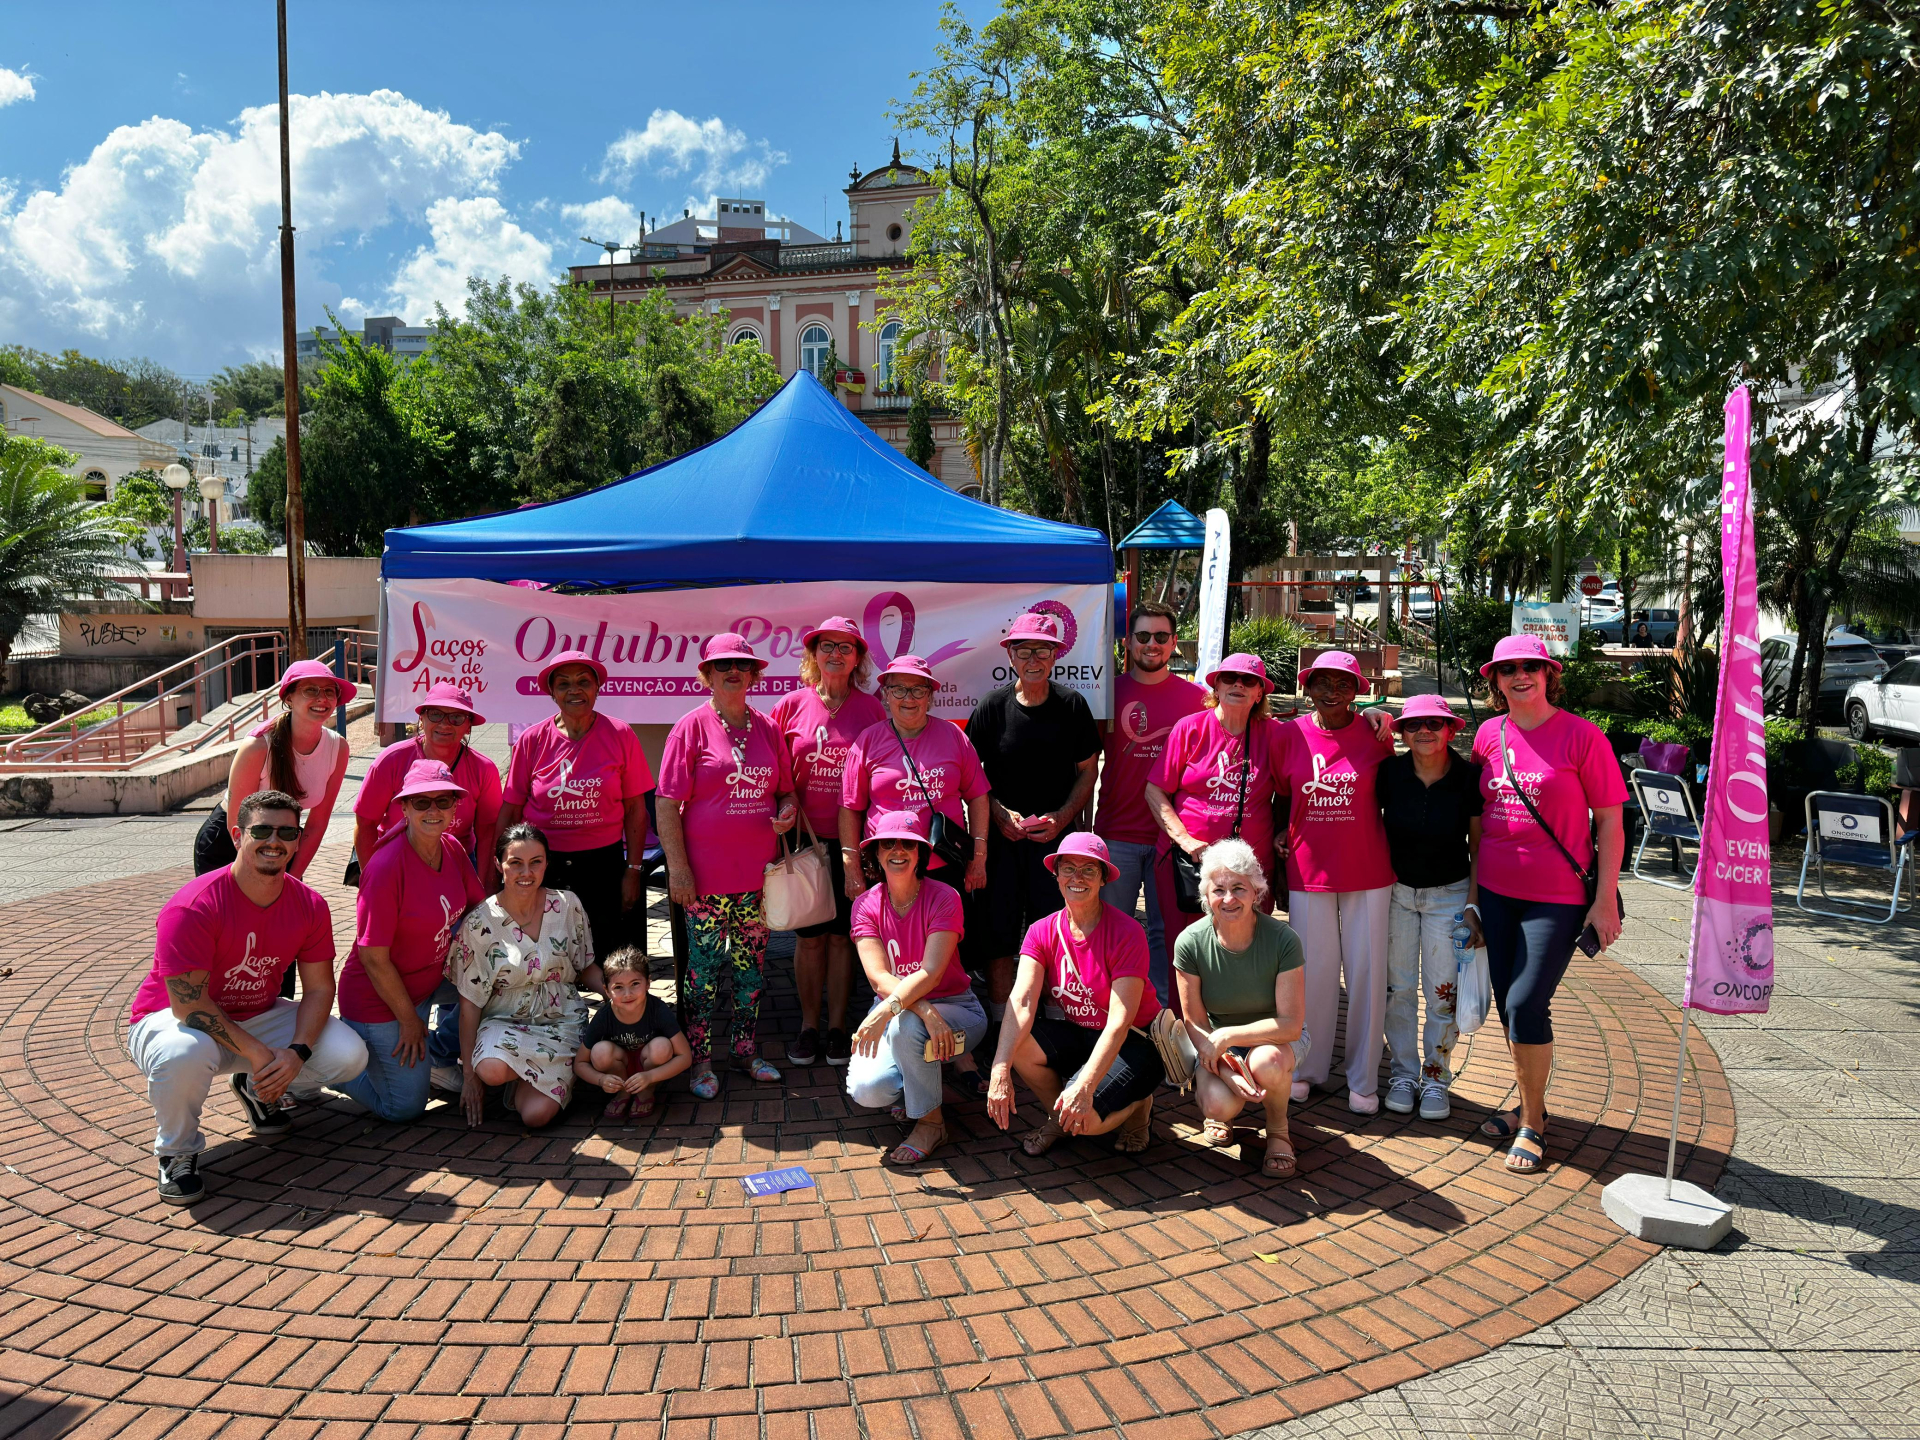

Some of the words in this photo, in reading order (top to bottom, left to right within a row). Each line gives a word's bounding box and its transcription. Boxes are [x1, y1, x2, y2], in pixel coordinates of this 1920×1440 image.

[392, 601, 488, 673] Laços
[462, 657, 483, 674] de
[992, 665, 1104, 681] ONPREV
[599, 679, 676, 695] REVENÇÃO
[682, 681, 703, 692] AO
[773, 680, 791, 692] DE
[934, 696, 979, 707] uidado
[547, 759, 603, 799] Laços
[1301, 753, 1359, 795] Laços
[758, 777, 769, 788] de
[931, 778, 945, 789] de
[1339, 783, 1355, 795] de
[1525, 783, 1541, 795] de
[586, 788, 600, 799] de
[1307, 792, 1352, 807] Amor
[554, 797, 599, 811] Amor
[1831, 830, 1869, 839] ONCOPREV
